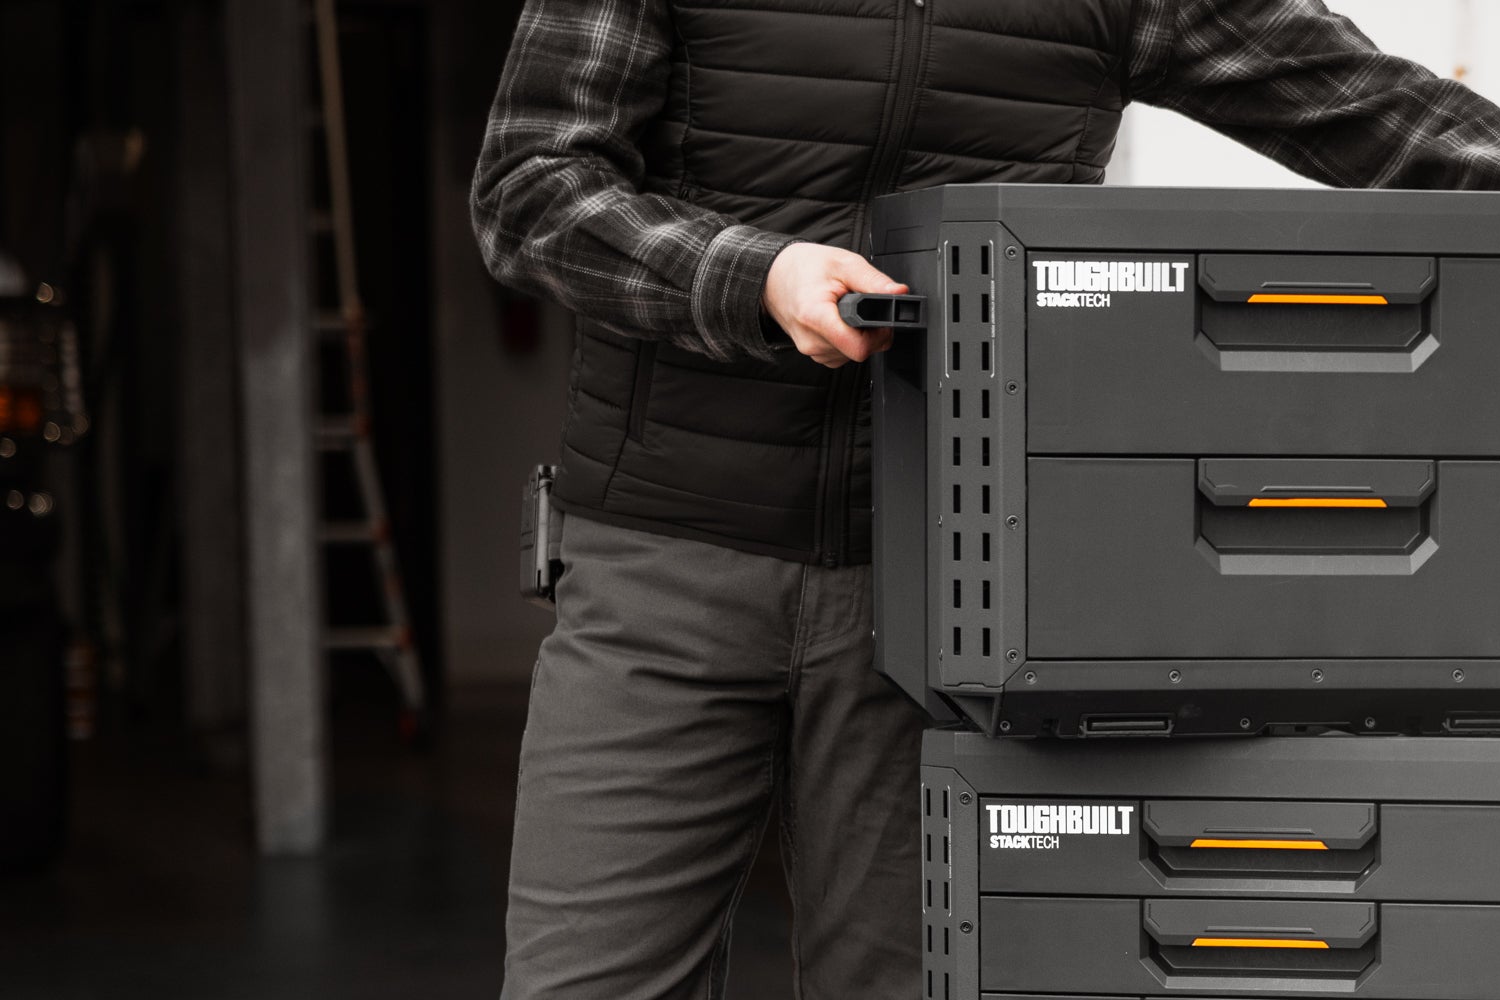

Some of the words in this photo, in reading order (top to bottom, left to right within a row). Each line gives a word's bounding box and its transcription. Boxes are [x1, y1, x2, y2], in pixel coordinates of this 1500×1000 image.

[1032, 261, 1189, 292] TOUGHBUILT
[1036, 292, 1110, 308] STACKTECH
[986, 805, 1133, 835] TOUGHBUILT
[989, 834, 1060, 849] STACKTECH
